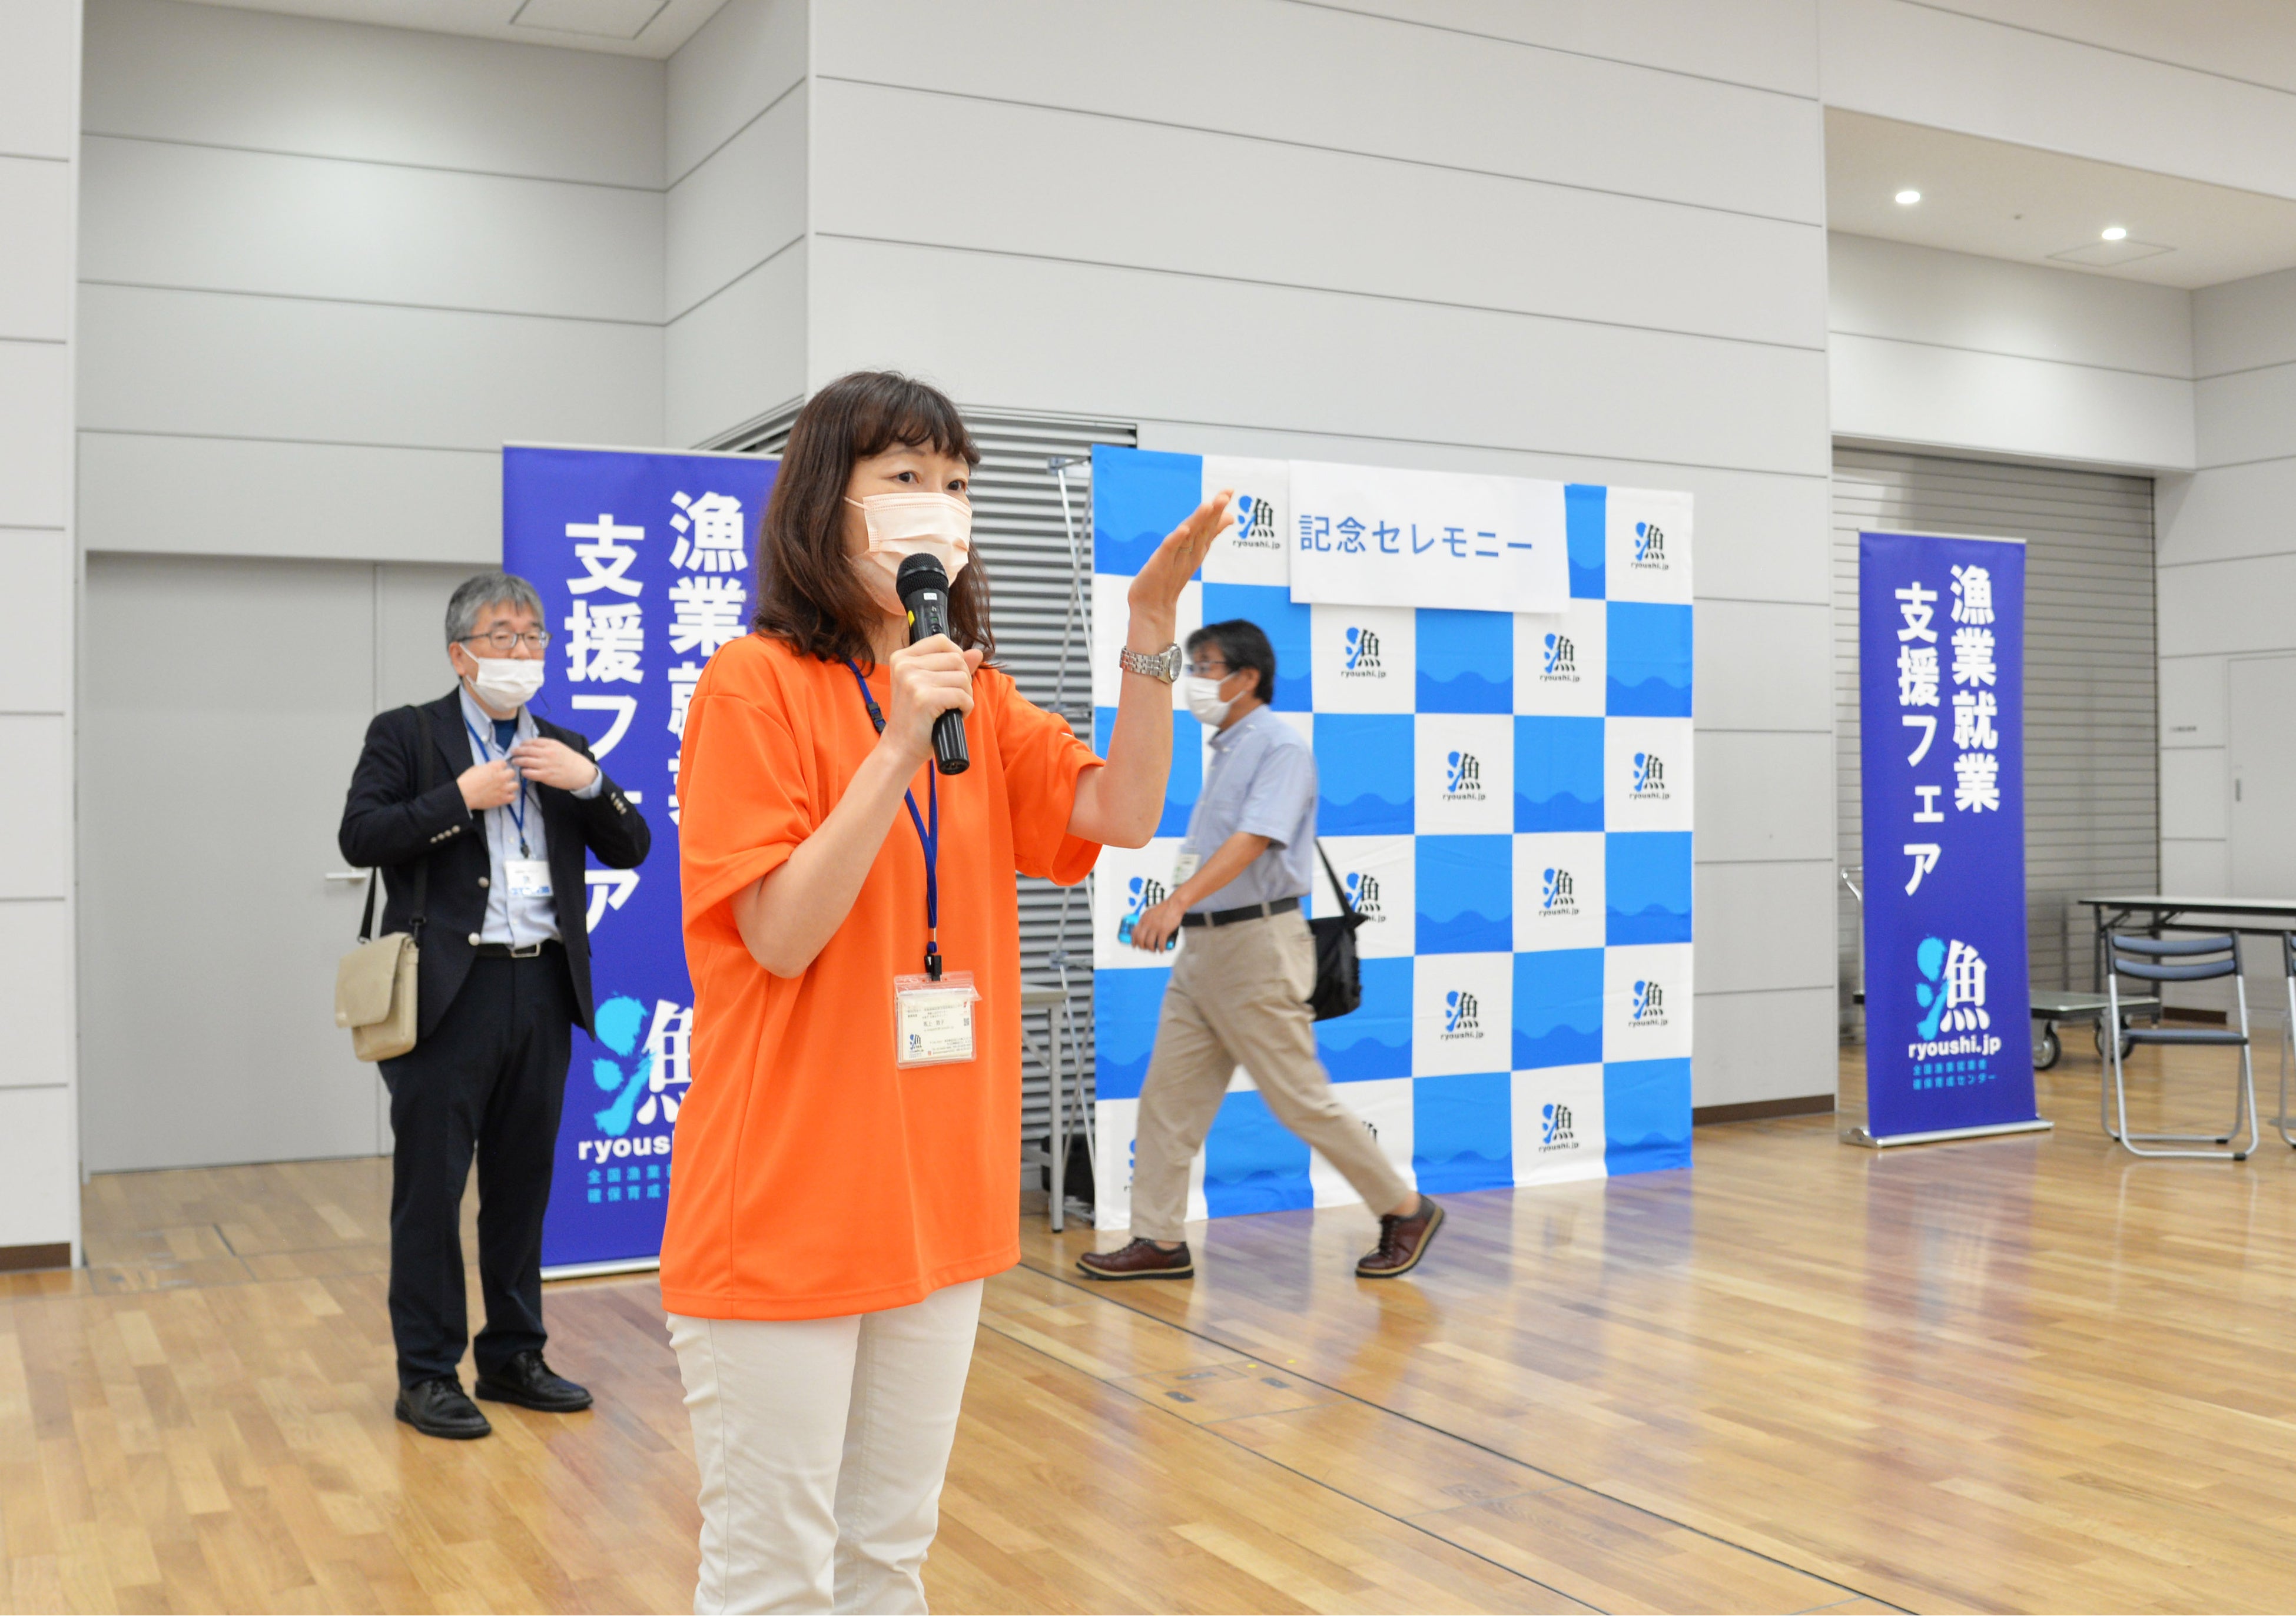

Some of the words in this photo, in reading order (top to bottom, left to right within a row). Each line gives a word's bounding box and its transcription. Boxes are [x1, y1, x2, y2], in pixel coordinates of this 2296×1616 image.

[1299, 515, 1532, 558] 記念セレモニー
[1233, 540, 1280, 550] ryoushi.jp
[1631, 561, 1669, 570] ryoushi.jp
[668, 491, 748, 825] 漁業
[1341, 670, 1386, 679] ryoushi.jp
[1539, 674, 1580, 683] ryoushi.jp
[1950, 565, 2000, 815] 漁業就業
[564, 514, 645, 934] 支援フア
[1894, 581, 1945, 896] 支援フェア
[1442, 792, 1486, 801] ryoushi.jp
[1629, 792, 1670, 801] ryoushi.jp
[1539, 907, 1579, 917] ryoushi.jp
[1628, 1018, 1668, 1028] ryoushi.jp
[1441, 1030, 1484, 1041] ryoushi.jp
[1908, 1034, 2001, 1061] ryoushi.jp
[578, 1131, 674, 1164] ryous
[1538, 1142, 1579, 1153] ryoushi.jp
